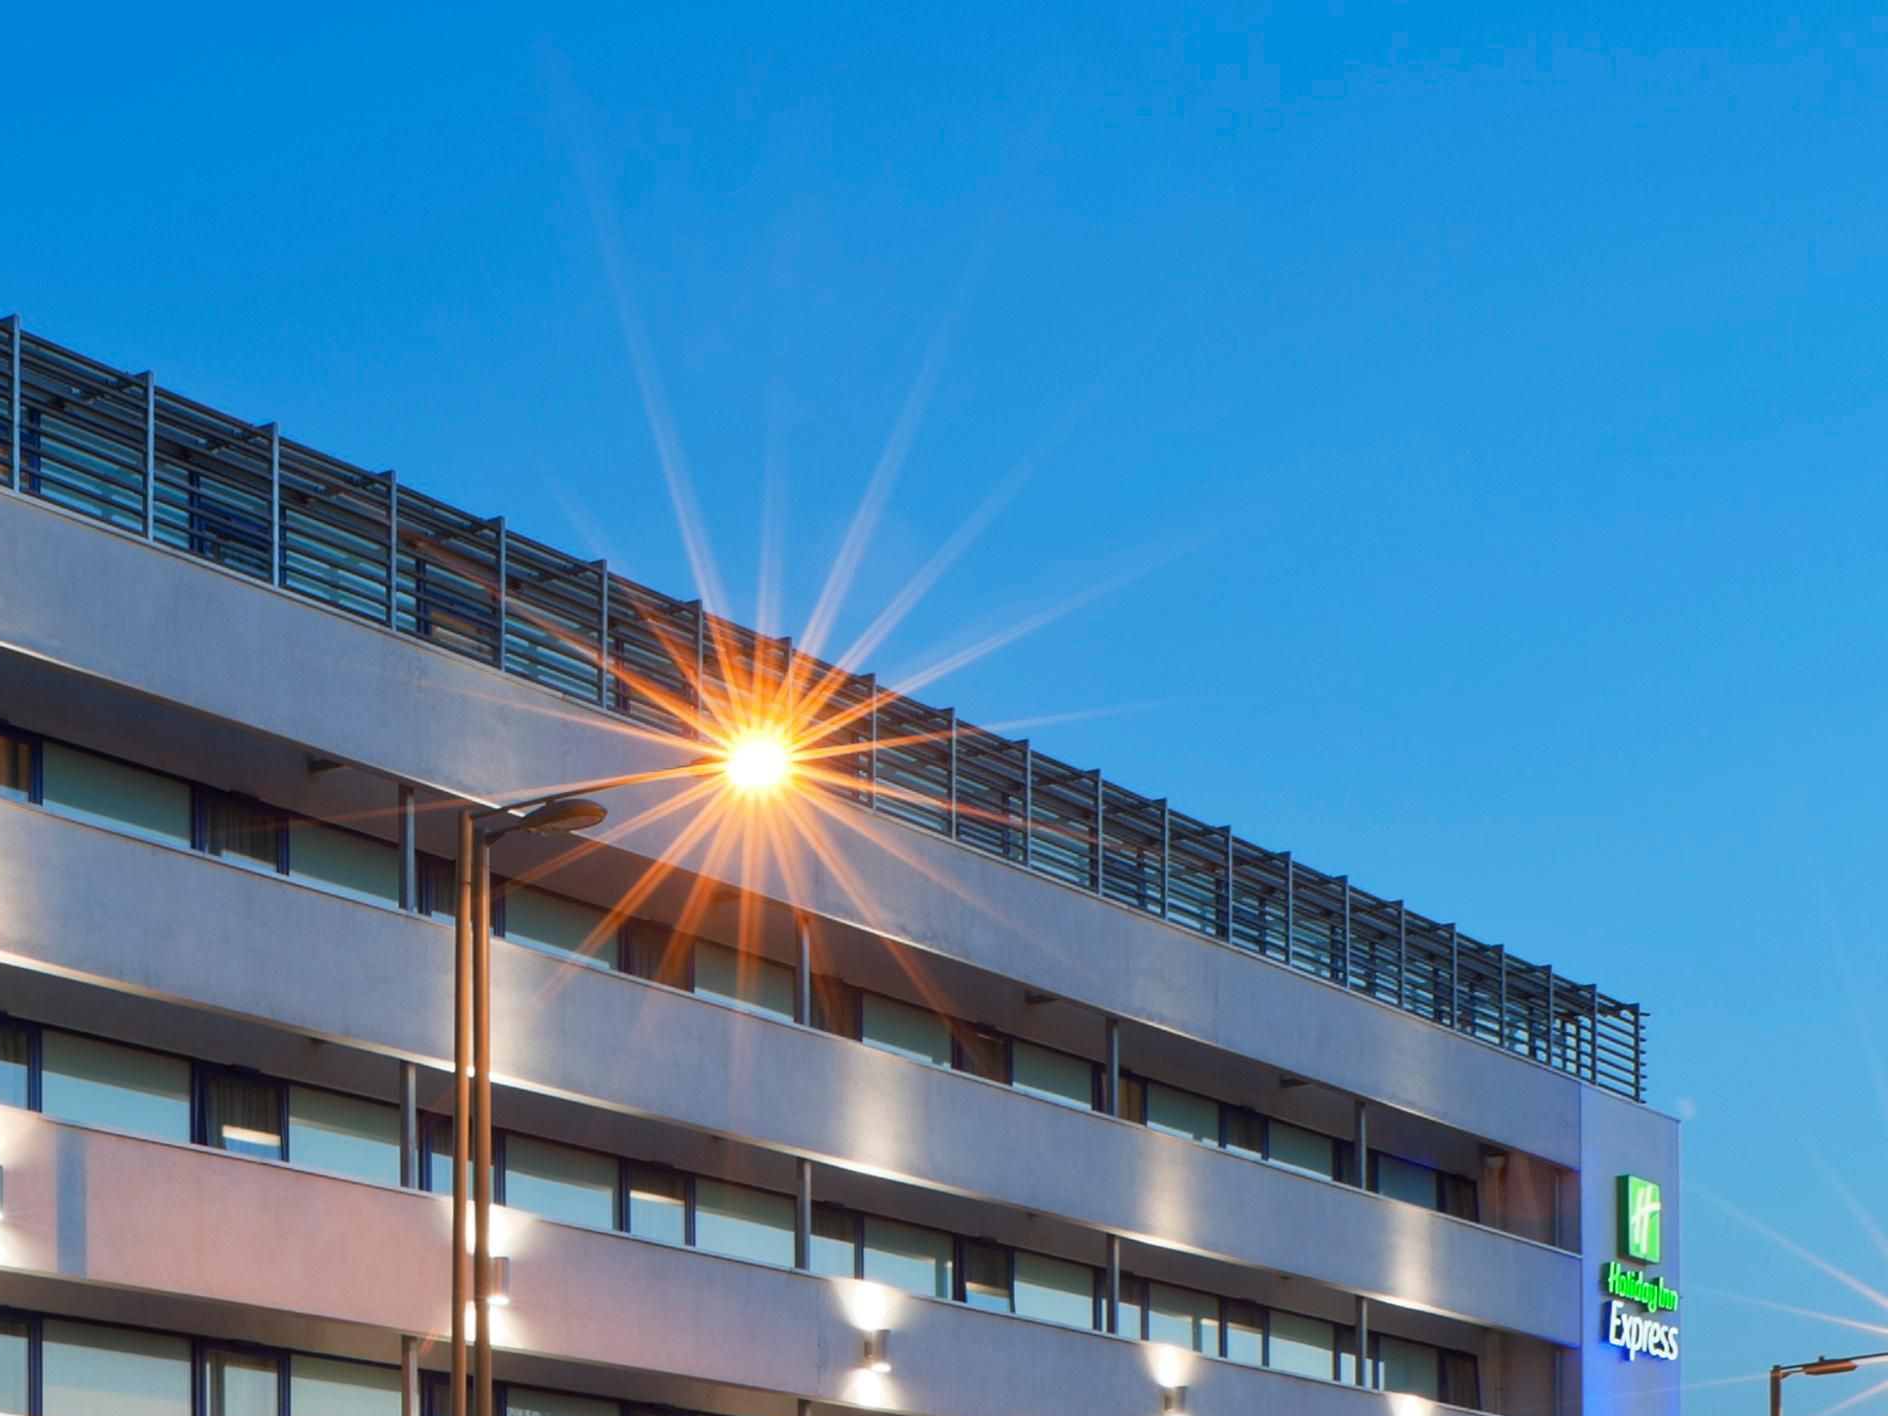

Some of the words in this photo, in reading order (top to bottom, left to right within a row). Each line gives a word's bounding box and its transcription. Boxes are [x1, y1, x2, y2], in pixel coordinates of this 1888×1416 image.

[1608, 1261, 1657, 1313] Holiday
[1659, 1276, 1679, 1312] Inn
[1609, 1300, 1679, 1361] Express
